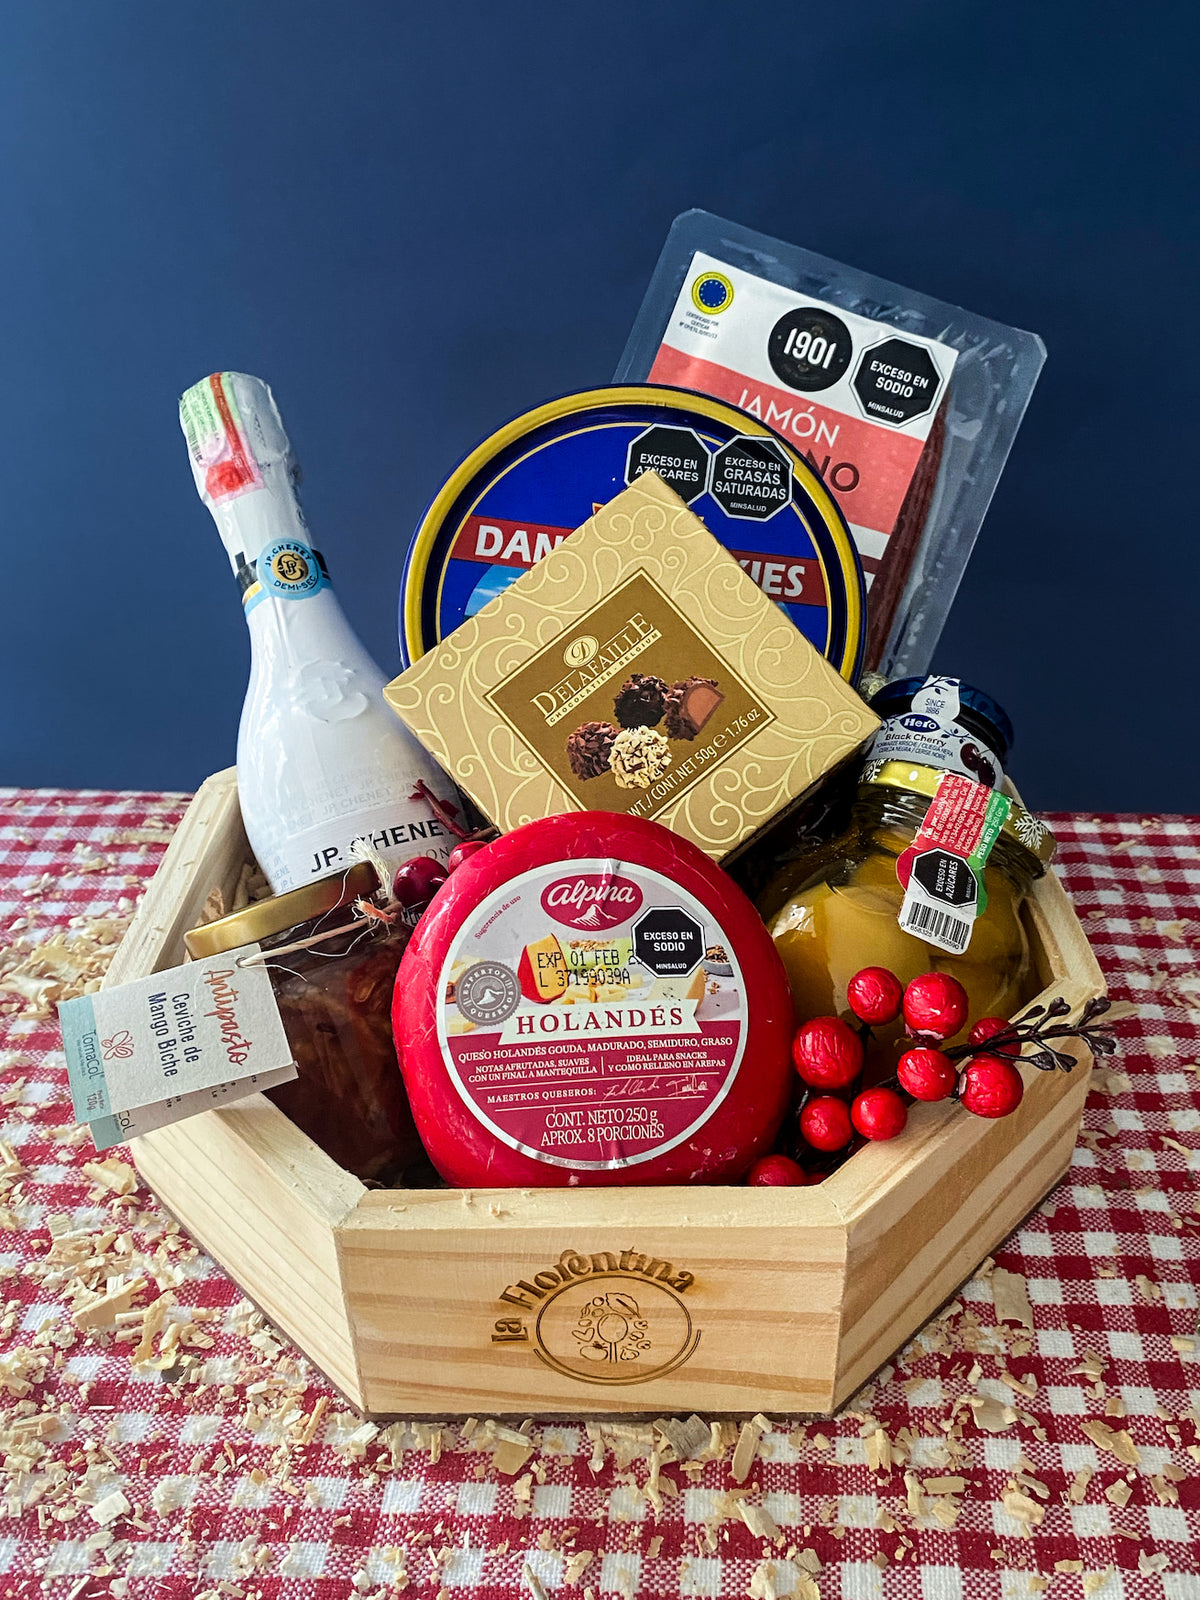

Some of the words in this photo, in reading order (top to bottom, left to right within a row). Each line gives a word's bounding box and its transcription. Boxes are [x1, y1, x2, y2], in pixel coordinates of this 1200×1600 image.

[783, 327, 837, 370] 1901
[870, 360, 912, 383] EXCESO
[913, 375, 929, 388] EN
[876, 377, 913, 398] SODIO
[868, 401, 904, 418] MINSALUD
[640, 453, 681, 468] EXCESO
[684, 459, 697, 469] EN
[725, 457, 766, 469] EXCESO
[768, 462, 781, 471] EN
[635, 466, 699, 481] AZCARES
[724, 468, 781, 485] GRASAS
[715, 481, 786, 499] SATURADAS
[730, 502, 767, 512] MINSALUD
[274, 575, 316, 590] DEMI-SEC
[738, 559, 805, 597] IES
[530, 613, 655, 719] DELAFAILLE
[550, 671, 612, 722] CHOCOLATIER
[619, 633, 658, 666] BELGIUM
[925, 698, 945, 709] SINCE
[925, 707, 940, 715] 1886
[904, 718, 937, 730] Hero
[695, 745, 717, 764] 50g
[725, 716, 749, 738] 1.76
[747, 708, 760, 722] oz
[885, 733, 911, 741] Black
[913, 734, 947, 747] Cherry
[311, 846, 343, 872] JP.
[351, 819, 454, 853] CHENE
[975, 842, 988, 859] PESO
[982, 827, 994, 843] NETO
[940, 859, 948, 868] EN
[935, 867, 947, 893] EXCESO
[945, 860, 958, 899] AZÚCARES
[548, 880, 635, 909] alpina
[474, 909, 502, 939] Sugerencia
[500, 901, 514, 912] de
[644, 932, 678, 941] EXCESO
[680, 931, 693, 940] EN
[653, 942, 685, 951] SODIO
[538, 952, 562, 968] EXP
[571, 951, 586, 967] 01
[595, 950, 620, 965] FEB
[463, 968, 505, 994] EXPERTOS
[540, 971, 548, 987] L
[470, 990, 513, 1018] QUESEROS
[148, 992, 169, 1038] Mango
[172, 993, 195, 1044] Ceviche
[203, 969, 253, 1067] Antipasto
[516, 1005, 683, 1035] HOLANDÉS
[157, 1038, 179, 1078] Biche
[183, 1045, 202, 1063] de
[459, 1051, 491, 1063] QUESO
[494, 1046, 546, 1059] HOLANDÉS
[548, 1046, 586, 1055] GOUDA,
[588, 1040, 646, 1052] MADURADO,
[648, 1038, 699, 1048] SEMIDURO,
[701, 1037, 732, 1045] GRASO
[627, 1053, 652, 1063] IDEAL
[653, 1053, 675, 1061] PARA
[469, 1074, 488, 1082] CON
[502, 1071, 527, 1080] FINAL
[536, 1066, 597, 1077] MANTEQUILLA
[476, 1062, 503, 1073] NOTAS
[504, 1060, 557, 1072] AFRUTADAS,
[558, 1058, 589, 1066] SUAVES
[615, 1063, 641, 1072] COMO
[642, 1061, 680, 1070] RELLENO
[683, 1060, 693, 1068] EN
[85, 1092, 97, 1111] 120g
[488, 1092, 540, 1103] MAESTROS
[542, 1088, 596, 1100] QUESEROS:
[546, 1111, 585, 1128] CONT.
[588, 1108, 624, 1125] NETO
[626, 1107, 648, 1122] 250
[650, 1110, 658, 1125] g
[541, 1129, 585, 1146] APROX.
[588, 1128, 595, 1142] 8
[597, 1123, 664, 1142] PORCIONES
[499, 1246, 695, 1310] Florentina
